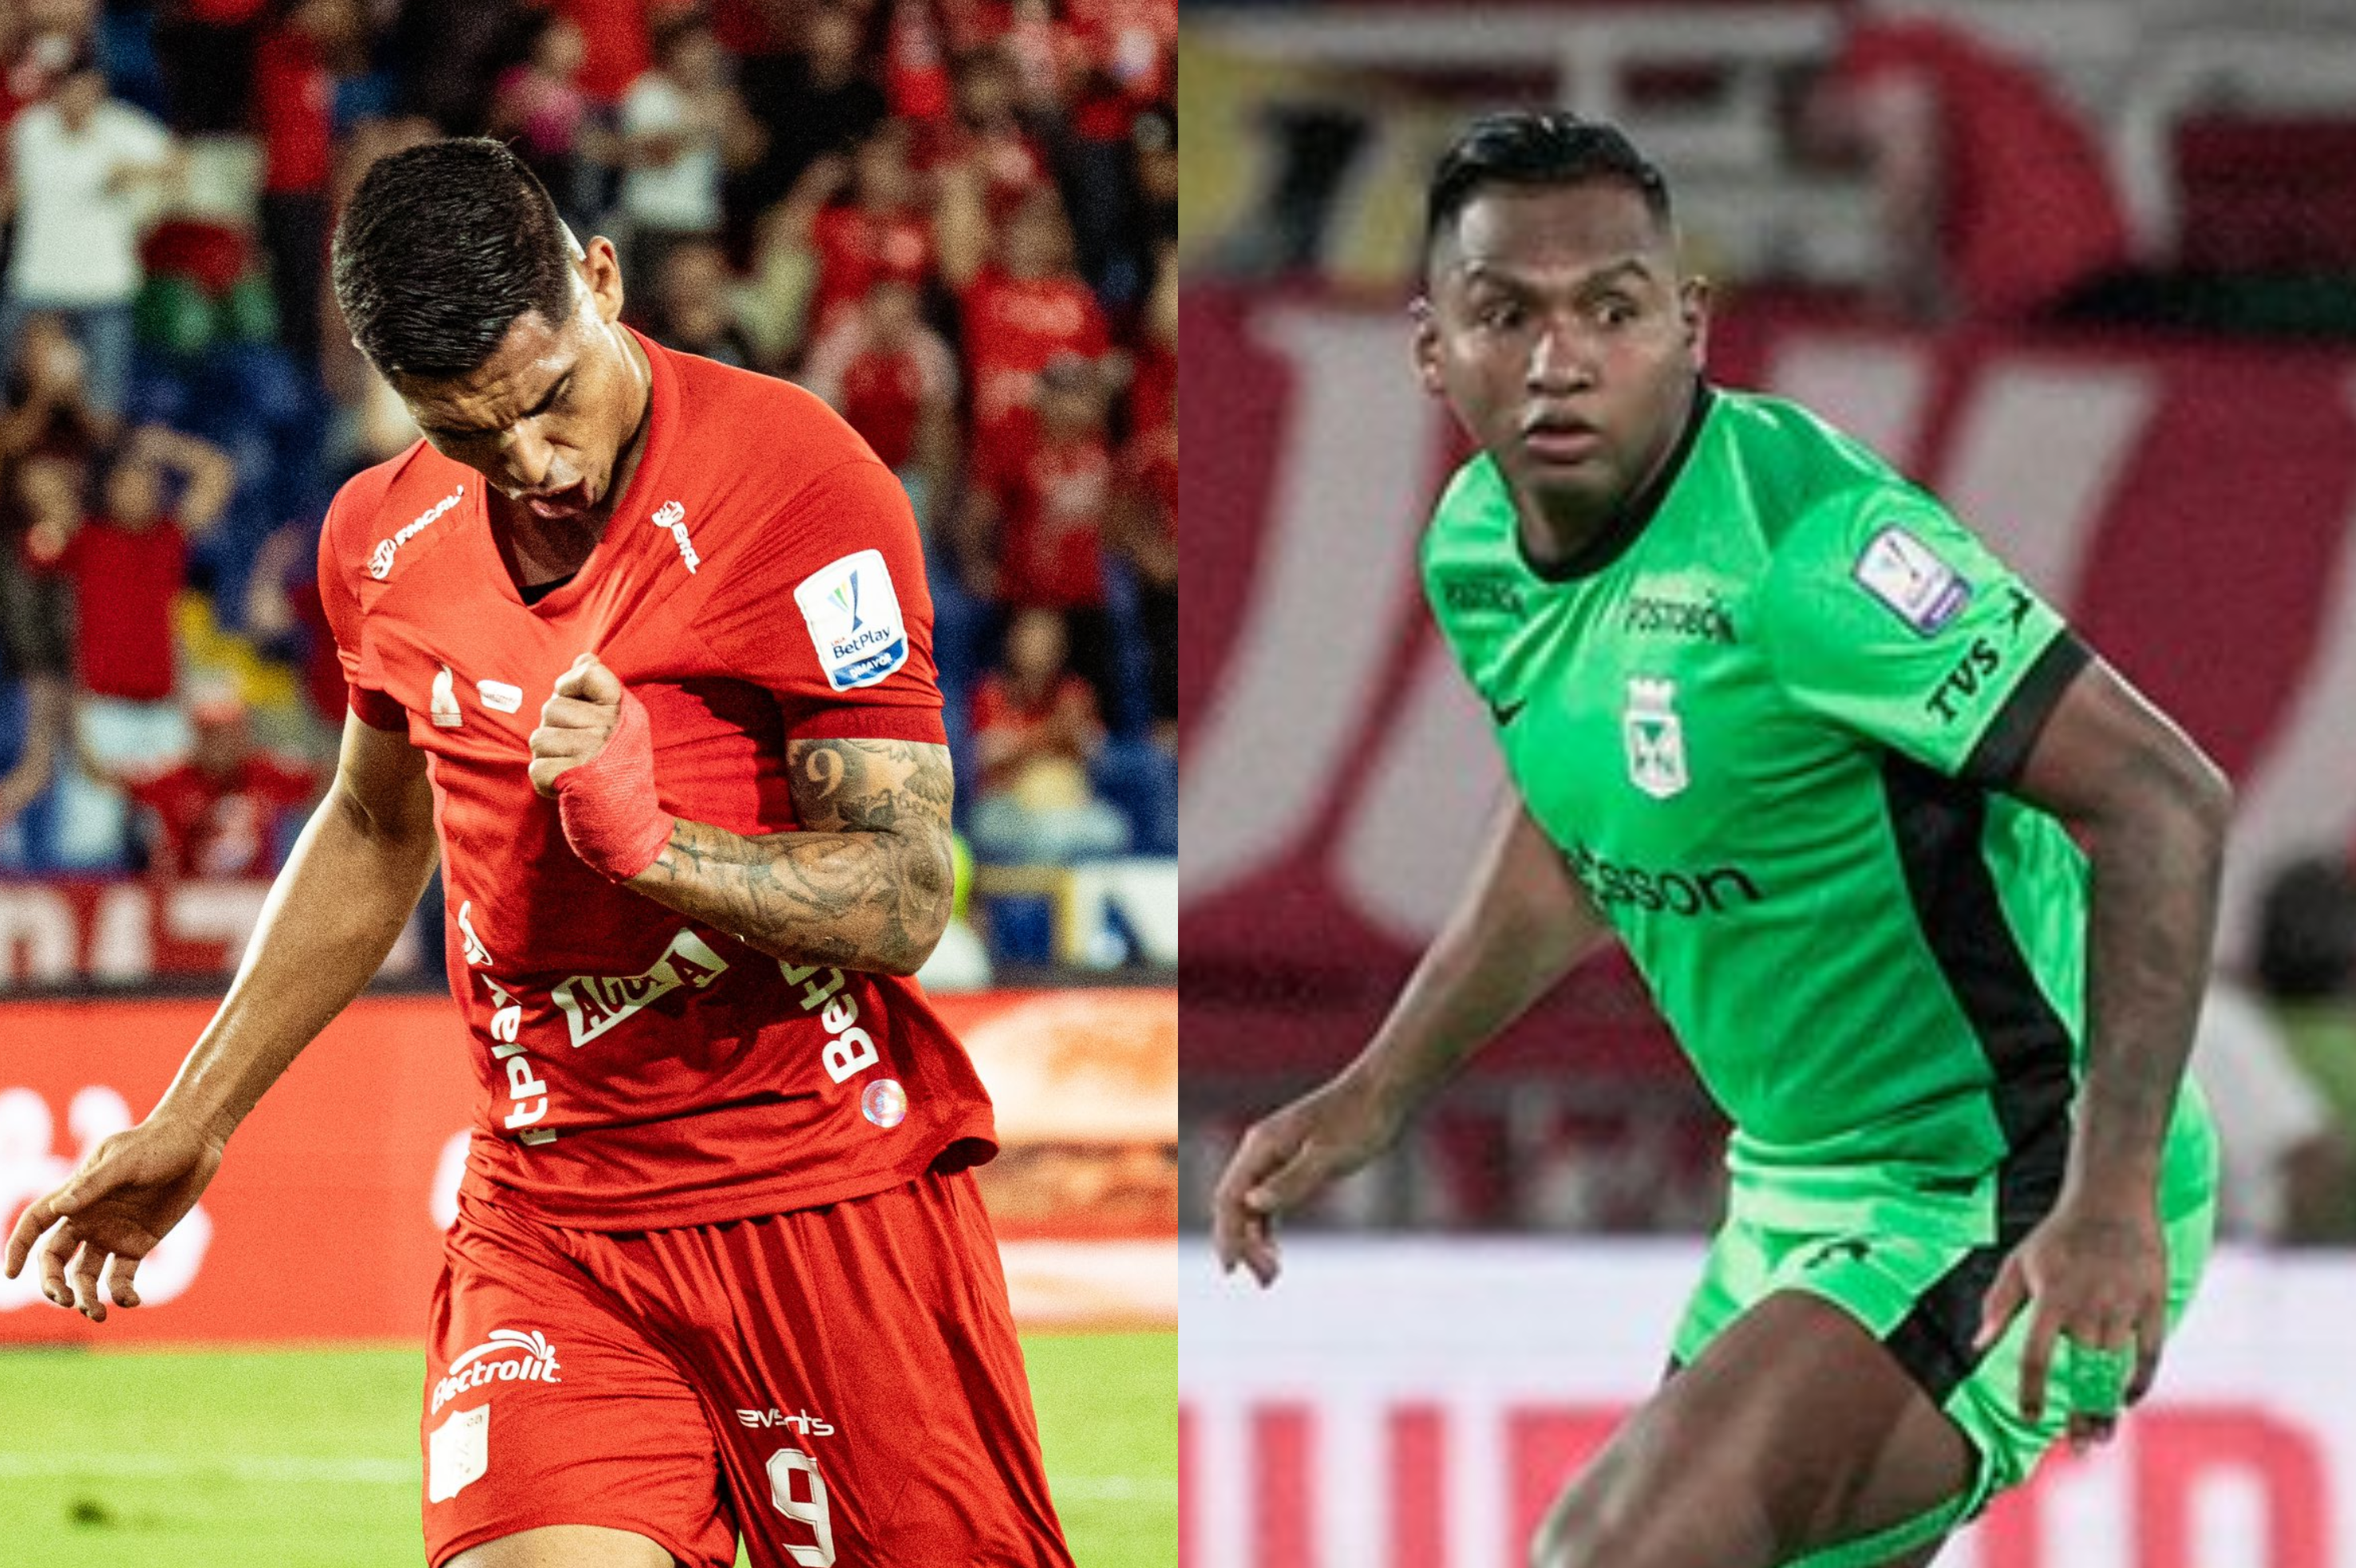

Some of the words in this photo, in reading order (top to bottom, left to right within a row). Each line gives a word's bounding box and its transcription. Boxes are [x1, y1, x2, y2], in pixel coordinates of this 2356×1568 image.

[832, 626, 891, 659] BetPlay
[848, 652, 893, 679] DIMAYOR
[1925, 638, 2000, 724] TVS
[765, 1447, 837, 1568] 9
